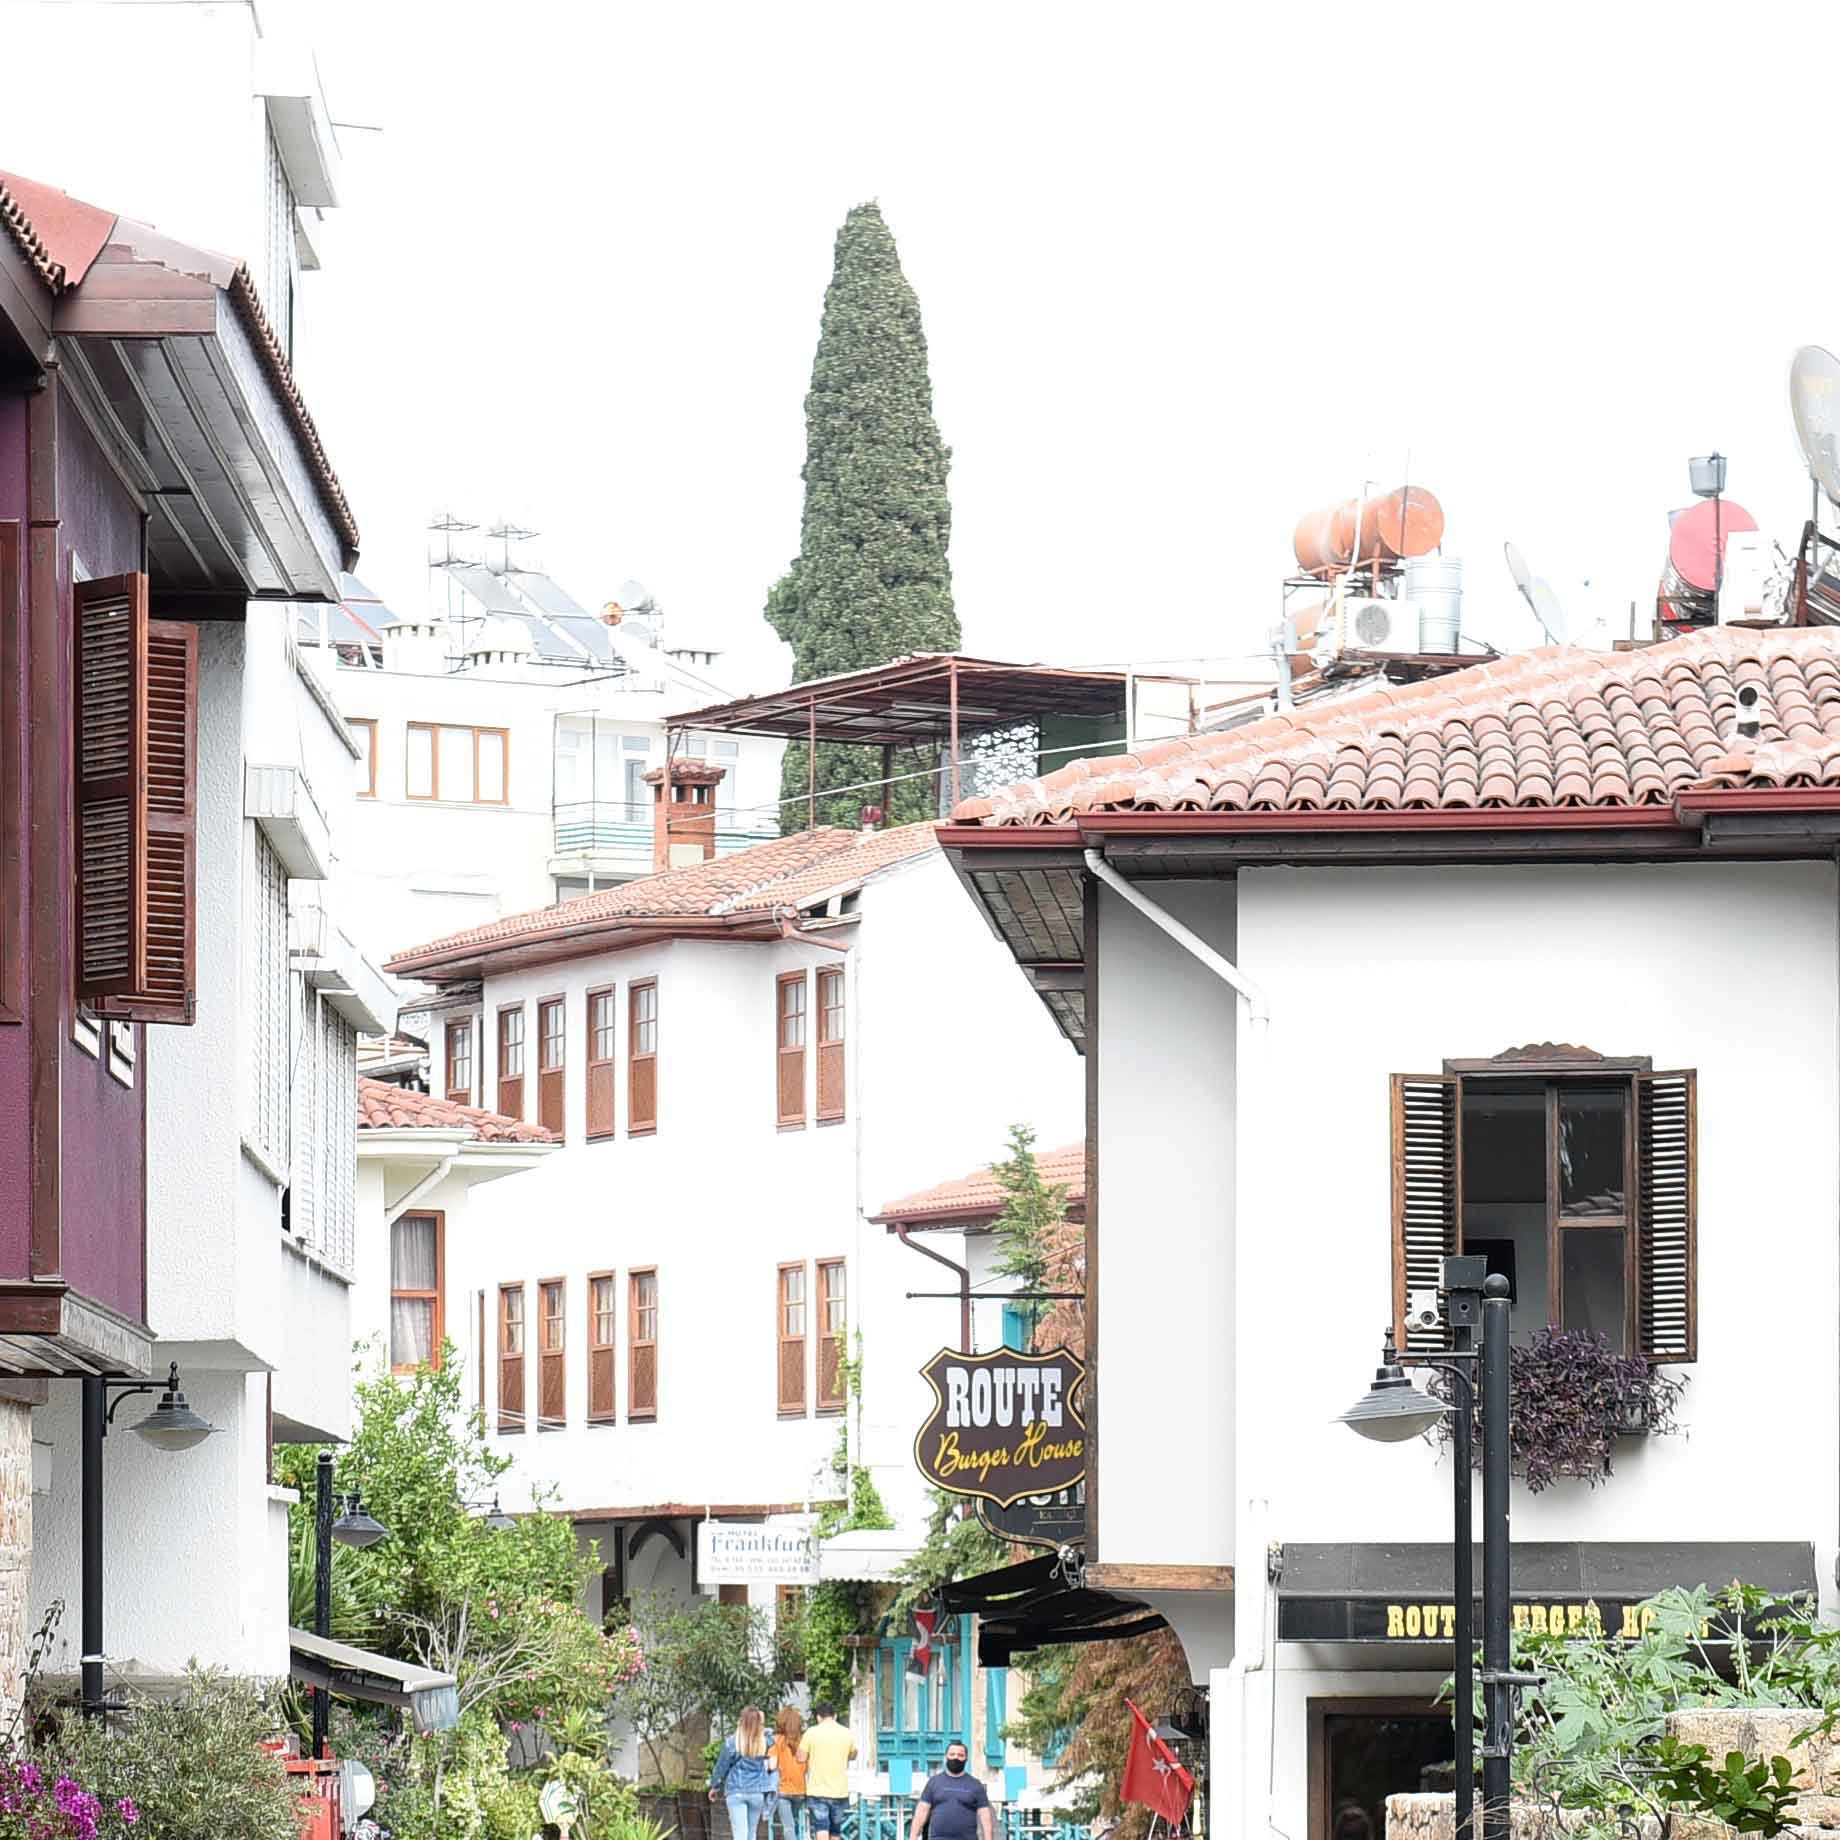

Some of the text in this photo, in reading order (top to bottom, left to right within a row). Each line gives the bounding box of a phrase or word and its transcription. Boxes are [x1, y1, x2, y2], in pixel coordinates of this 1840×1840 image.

[946, 1366, 1062, 1427] ROUTE
[933, 1420, 1083, 1482] Burger House
[1386, 1605, 1456, 1637] ROUT
